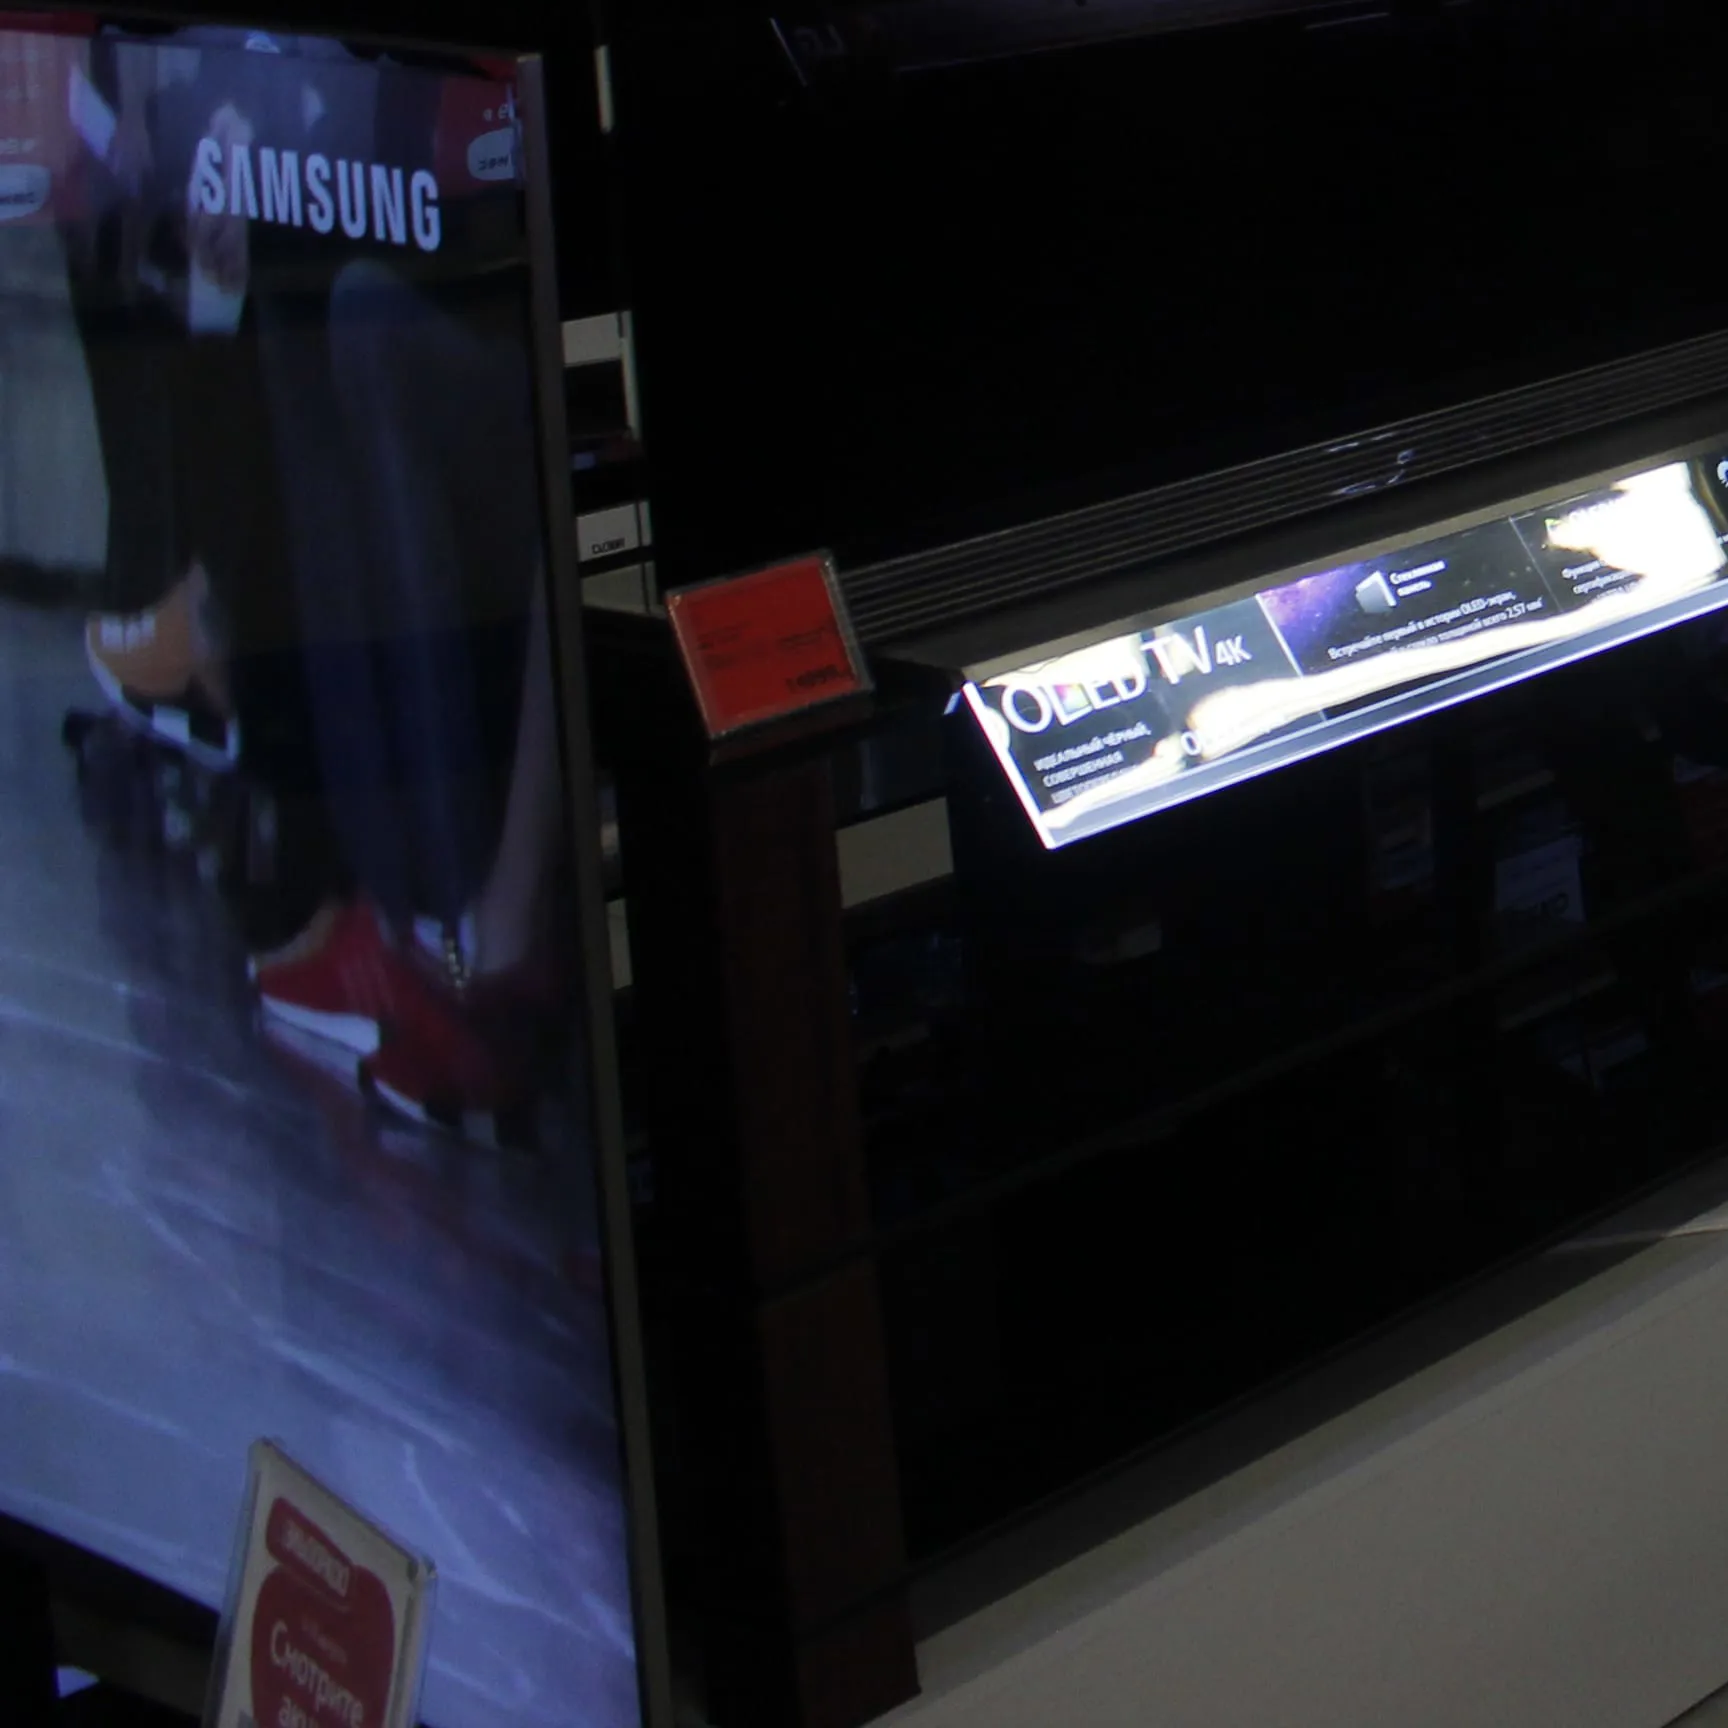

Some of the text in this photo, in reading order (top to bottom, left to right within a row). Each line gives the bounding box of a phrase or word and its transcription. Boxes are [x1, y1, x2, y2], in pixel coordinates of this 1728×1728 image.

[199, 136, 443, 253] SAMSUNG
[1141, 626, 1213, 685] TV
[1215, 635, 1252, 666] 4K
